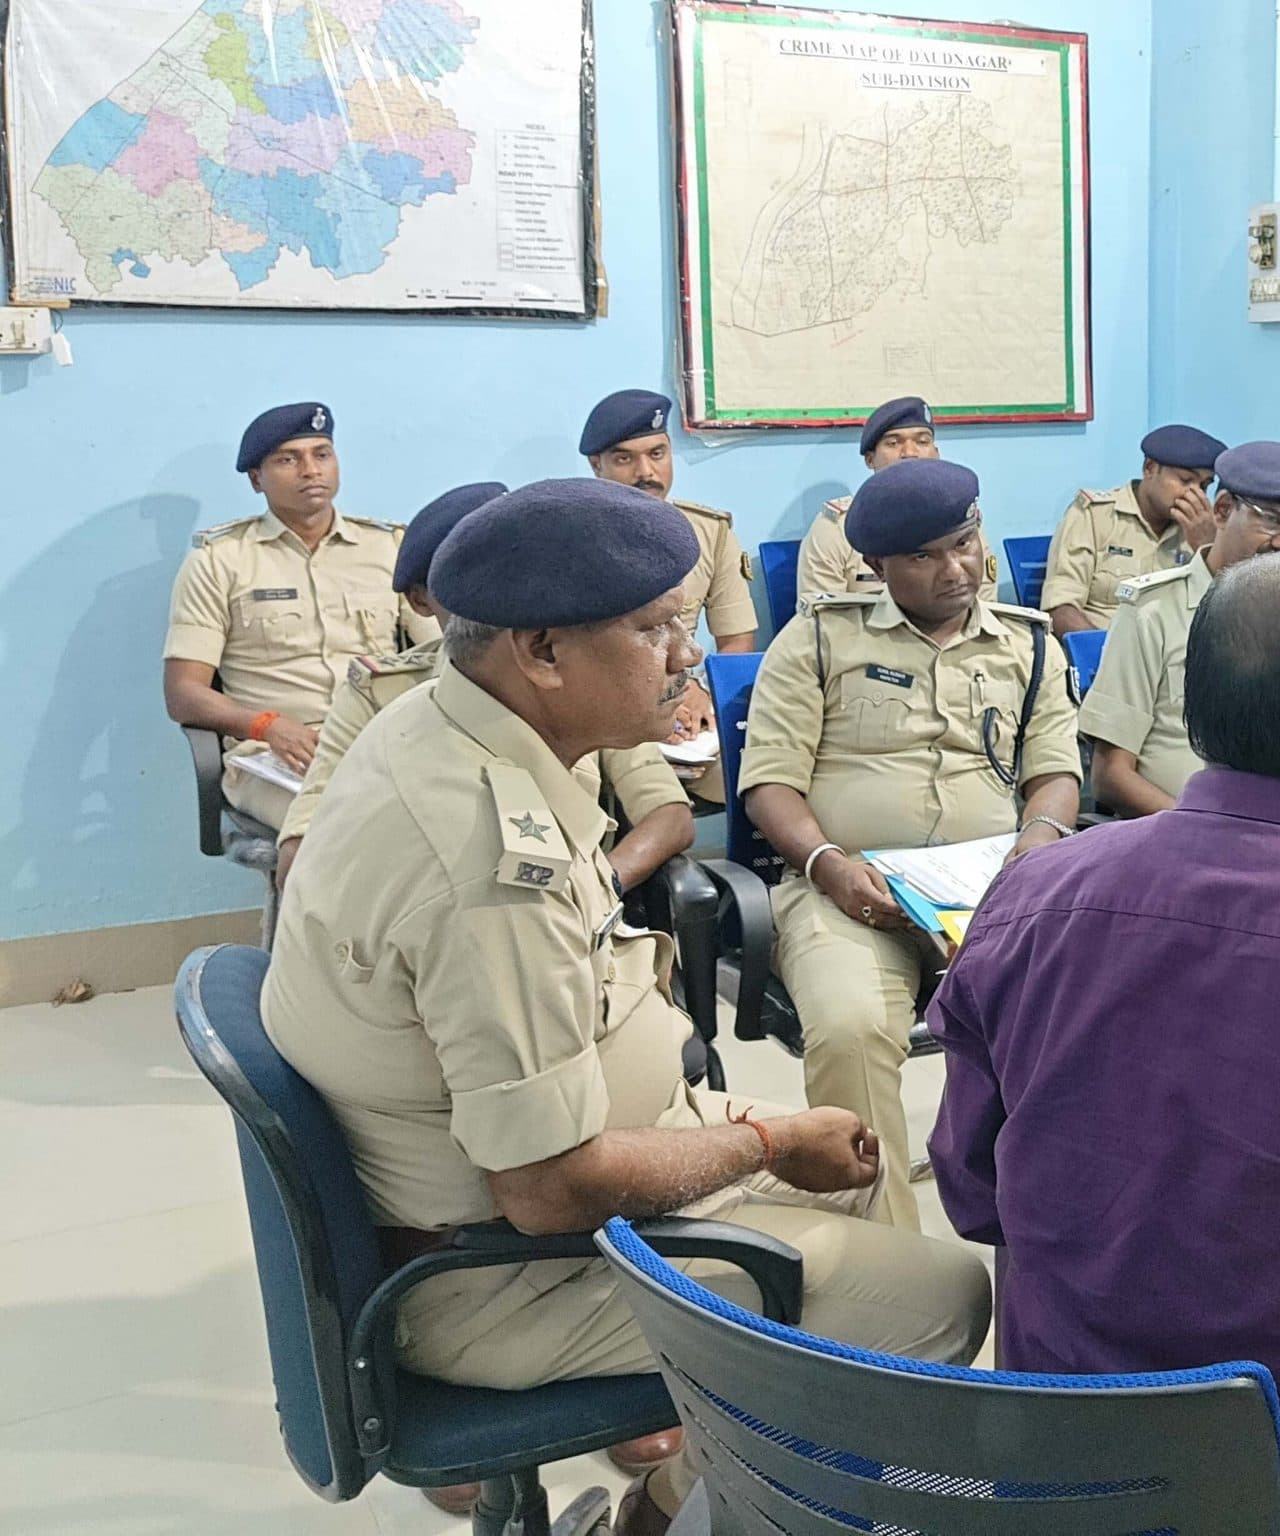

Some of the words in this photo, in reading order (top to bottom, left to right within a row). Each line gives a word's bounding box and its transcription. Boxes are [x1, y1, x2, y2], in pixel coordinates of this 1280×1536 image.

[779, 39, 833, 54] CRIME
[841, 43, 877, 58] MAP
[882, 48, 902, 60] OF
[909, 50, 1009, 69] DAUDNAGAR
[860, 72, 971, 89] SUB-DIVISION
[54, 276, 77, 291] NIC
